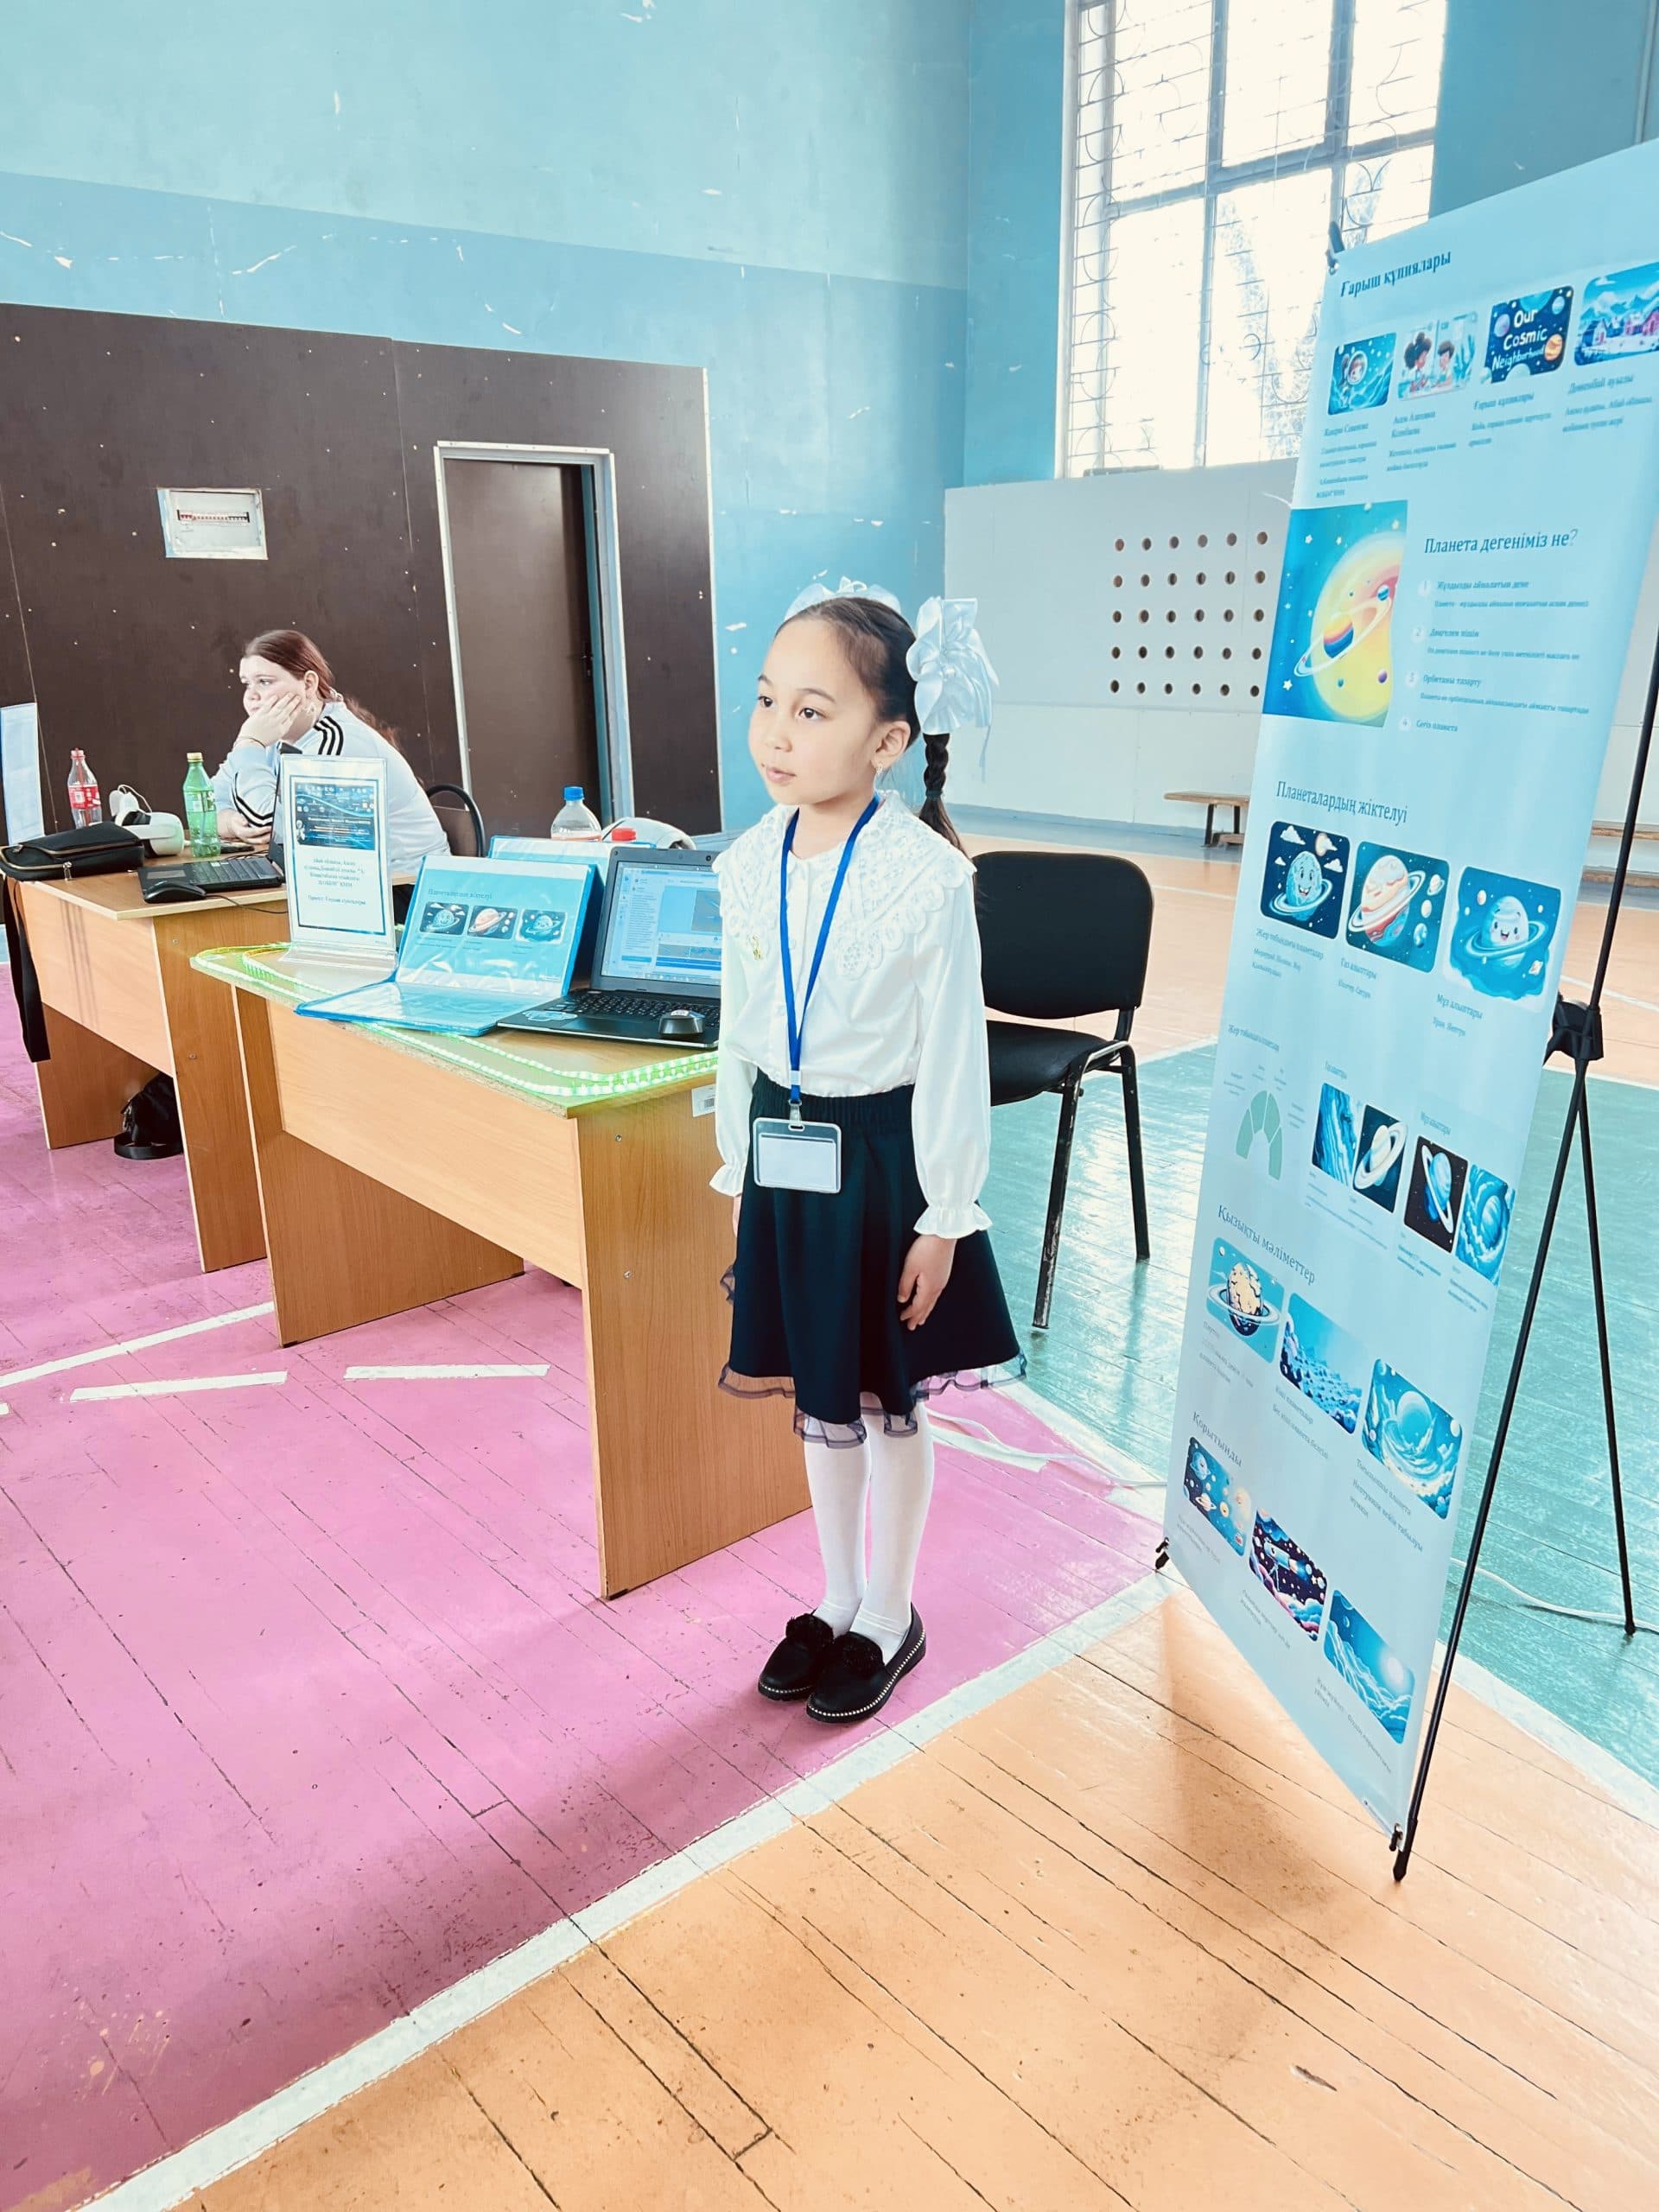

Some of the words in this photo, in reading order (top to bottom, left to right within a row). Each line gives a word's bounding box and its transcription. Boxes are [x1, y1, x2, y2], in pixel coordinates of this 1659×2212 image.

[1514, 309, 1538, 327] Our
[1503, 325, 1548, 351] Cosmic
[1425, 537, 1478, 554] Планета
[1479, 531, 1548, 553] дегеніміз
[1551, 528, 1579, 548] не?
[1275, 780, 1357, 816] Планеталардың
[1357, 798, 1408, 827] жіктелуі
[1262, 1237, 1315, 1286] мәліметтер
